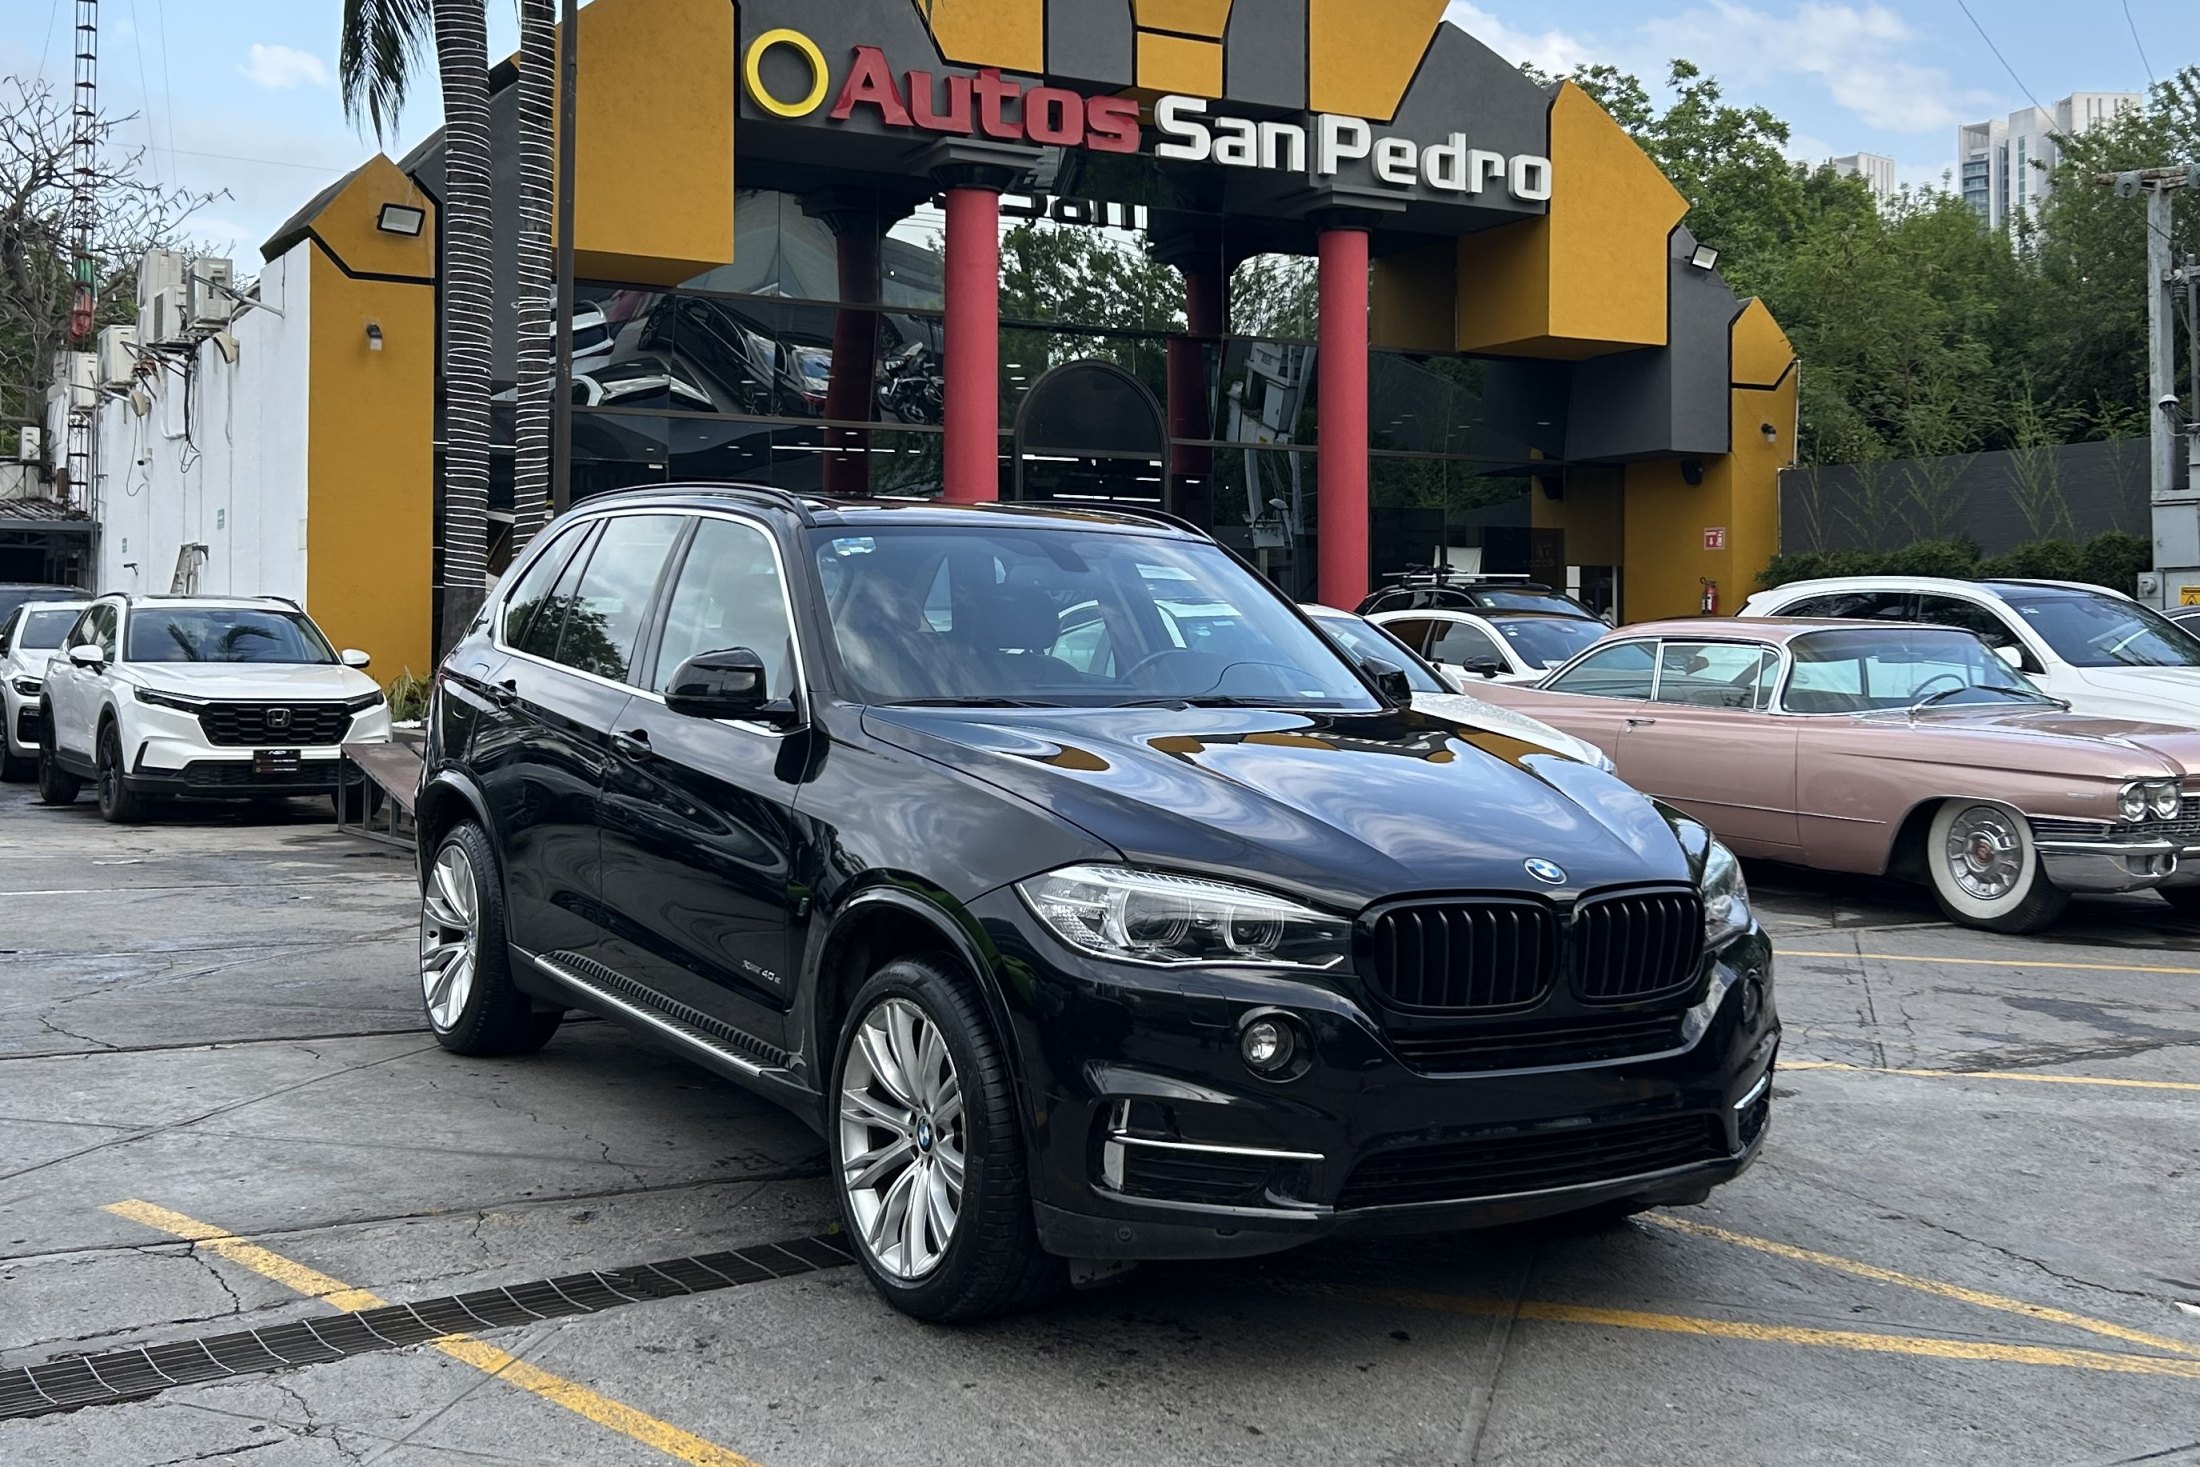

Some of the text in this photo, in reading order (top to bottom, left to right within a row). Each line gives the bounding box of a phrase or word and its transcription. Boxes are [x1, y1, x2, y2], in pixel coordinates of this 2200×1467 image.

[829, 45, 1552, 201] Autos San Pedro
